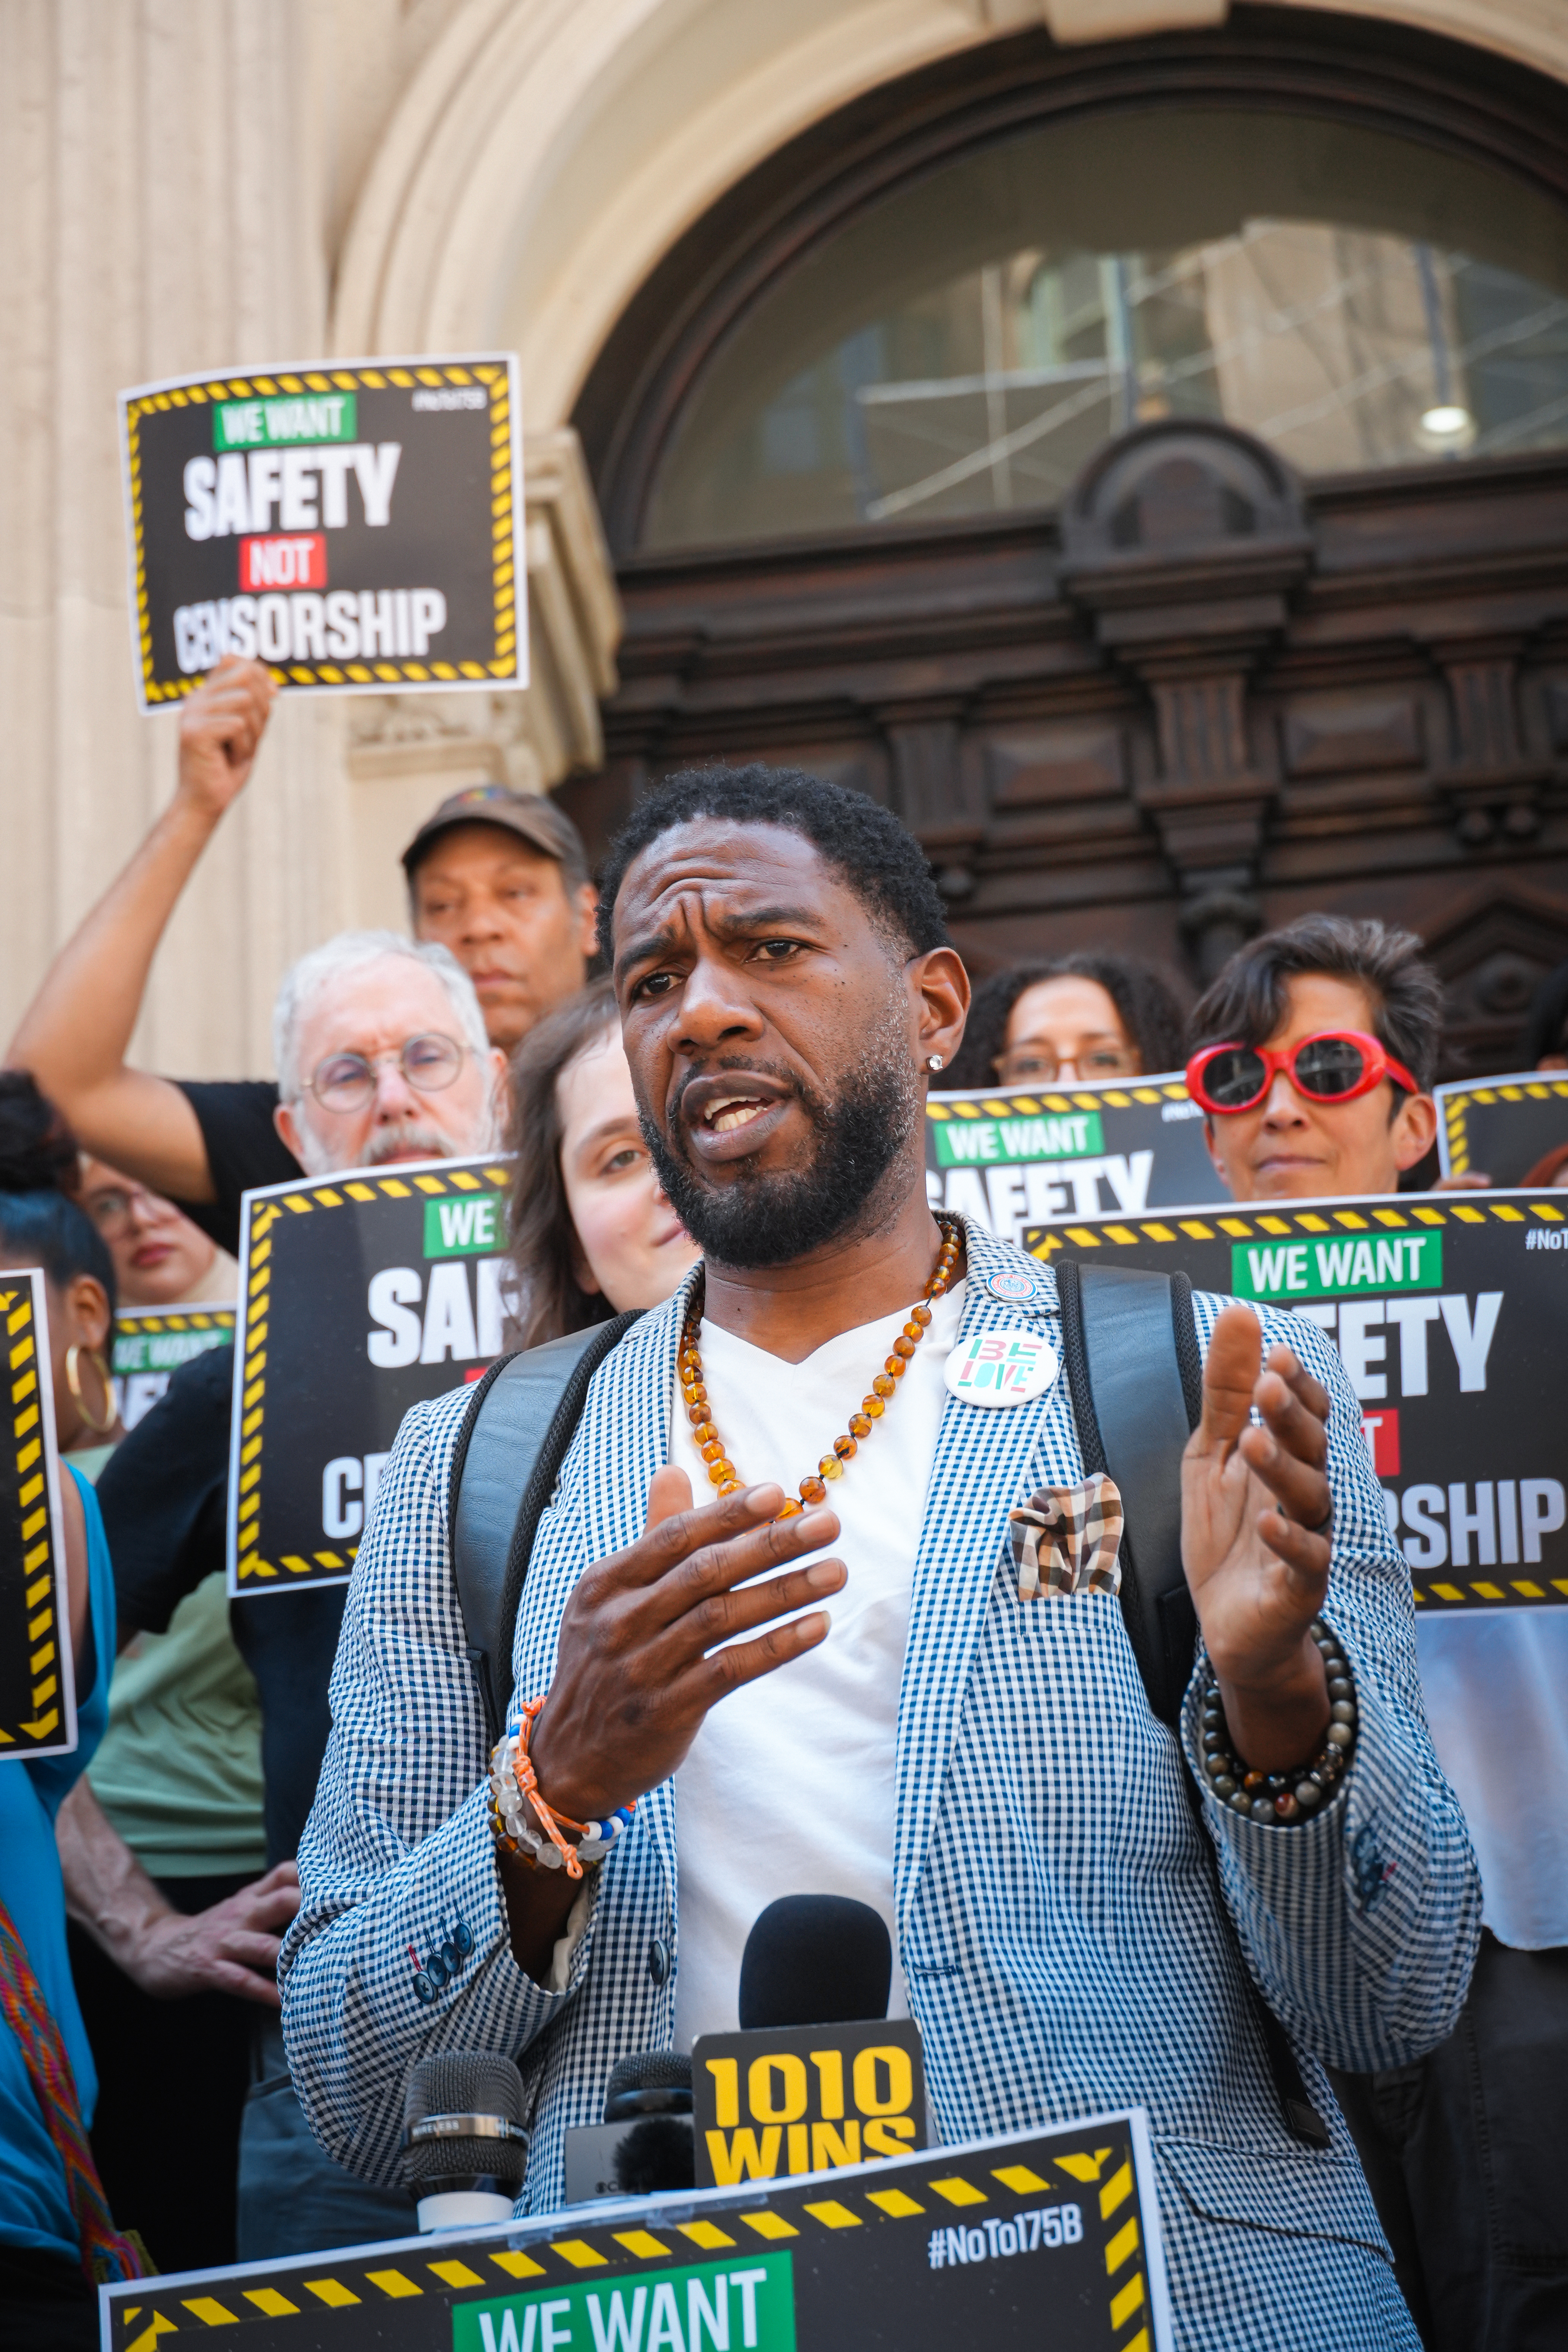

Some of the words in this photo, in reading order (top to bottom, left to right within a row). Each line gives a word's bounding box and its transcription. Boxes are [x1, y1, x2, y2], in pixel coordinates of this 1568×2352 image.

[221, 401, 264, 444] WE
[265, 396, 345, 440] WANT
[183, 441, 401, 541] SAFETY
[249, 539, 315, 586] NOT
[174, 588, 447, 673] CENSORSHIP
[946, 1122, 999, 1160] WE
[999, 1115, 1090, 1156] WANT
[439, 1199, 495, 1247] WE
[1247, 1245, 1307, 1292] WE
[1315, 1237, 1426, 1287] WANT
[957, 1361, 1034, 1393] LOVE
[968, 1339, 1043, 1365] BE
[705, 2045, 913, 2128] 1010
[704, 2116, 916, 2187] WINS
[585, 2268, 767, 2352] WANT
